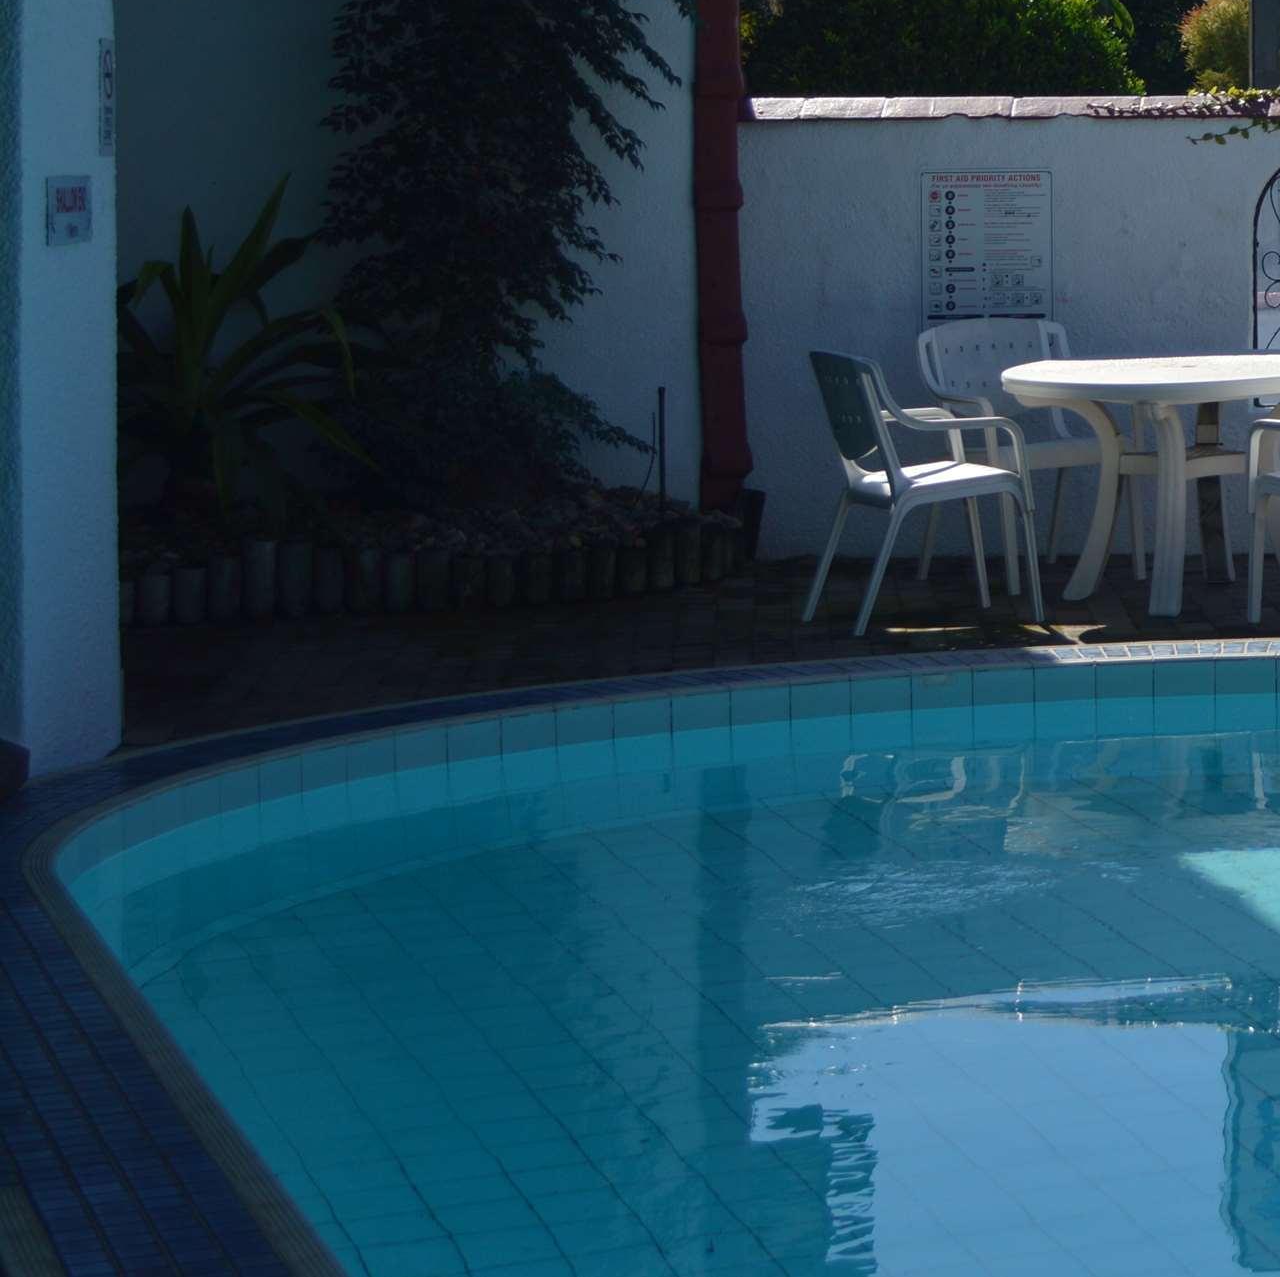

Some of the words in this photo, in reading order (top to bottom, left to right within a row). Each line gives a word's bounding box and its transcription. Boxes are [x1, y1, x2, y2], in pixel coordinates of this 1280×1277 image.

[931, 174, 953, 183] FIRST
[956, 174, 969, 183] AID
[971, 174, 1005, 182] PRIORITY
[1008, 173, 1041, 182] ACTIONS
